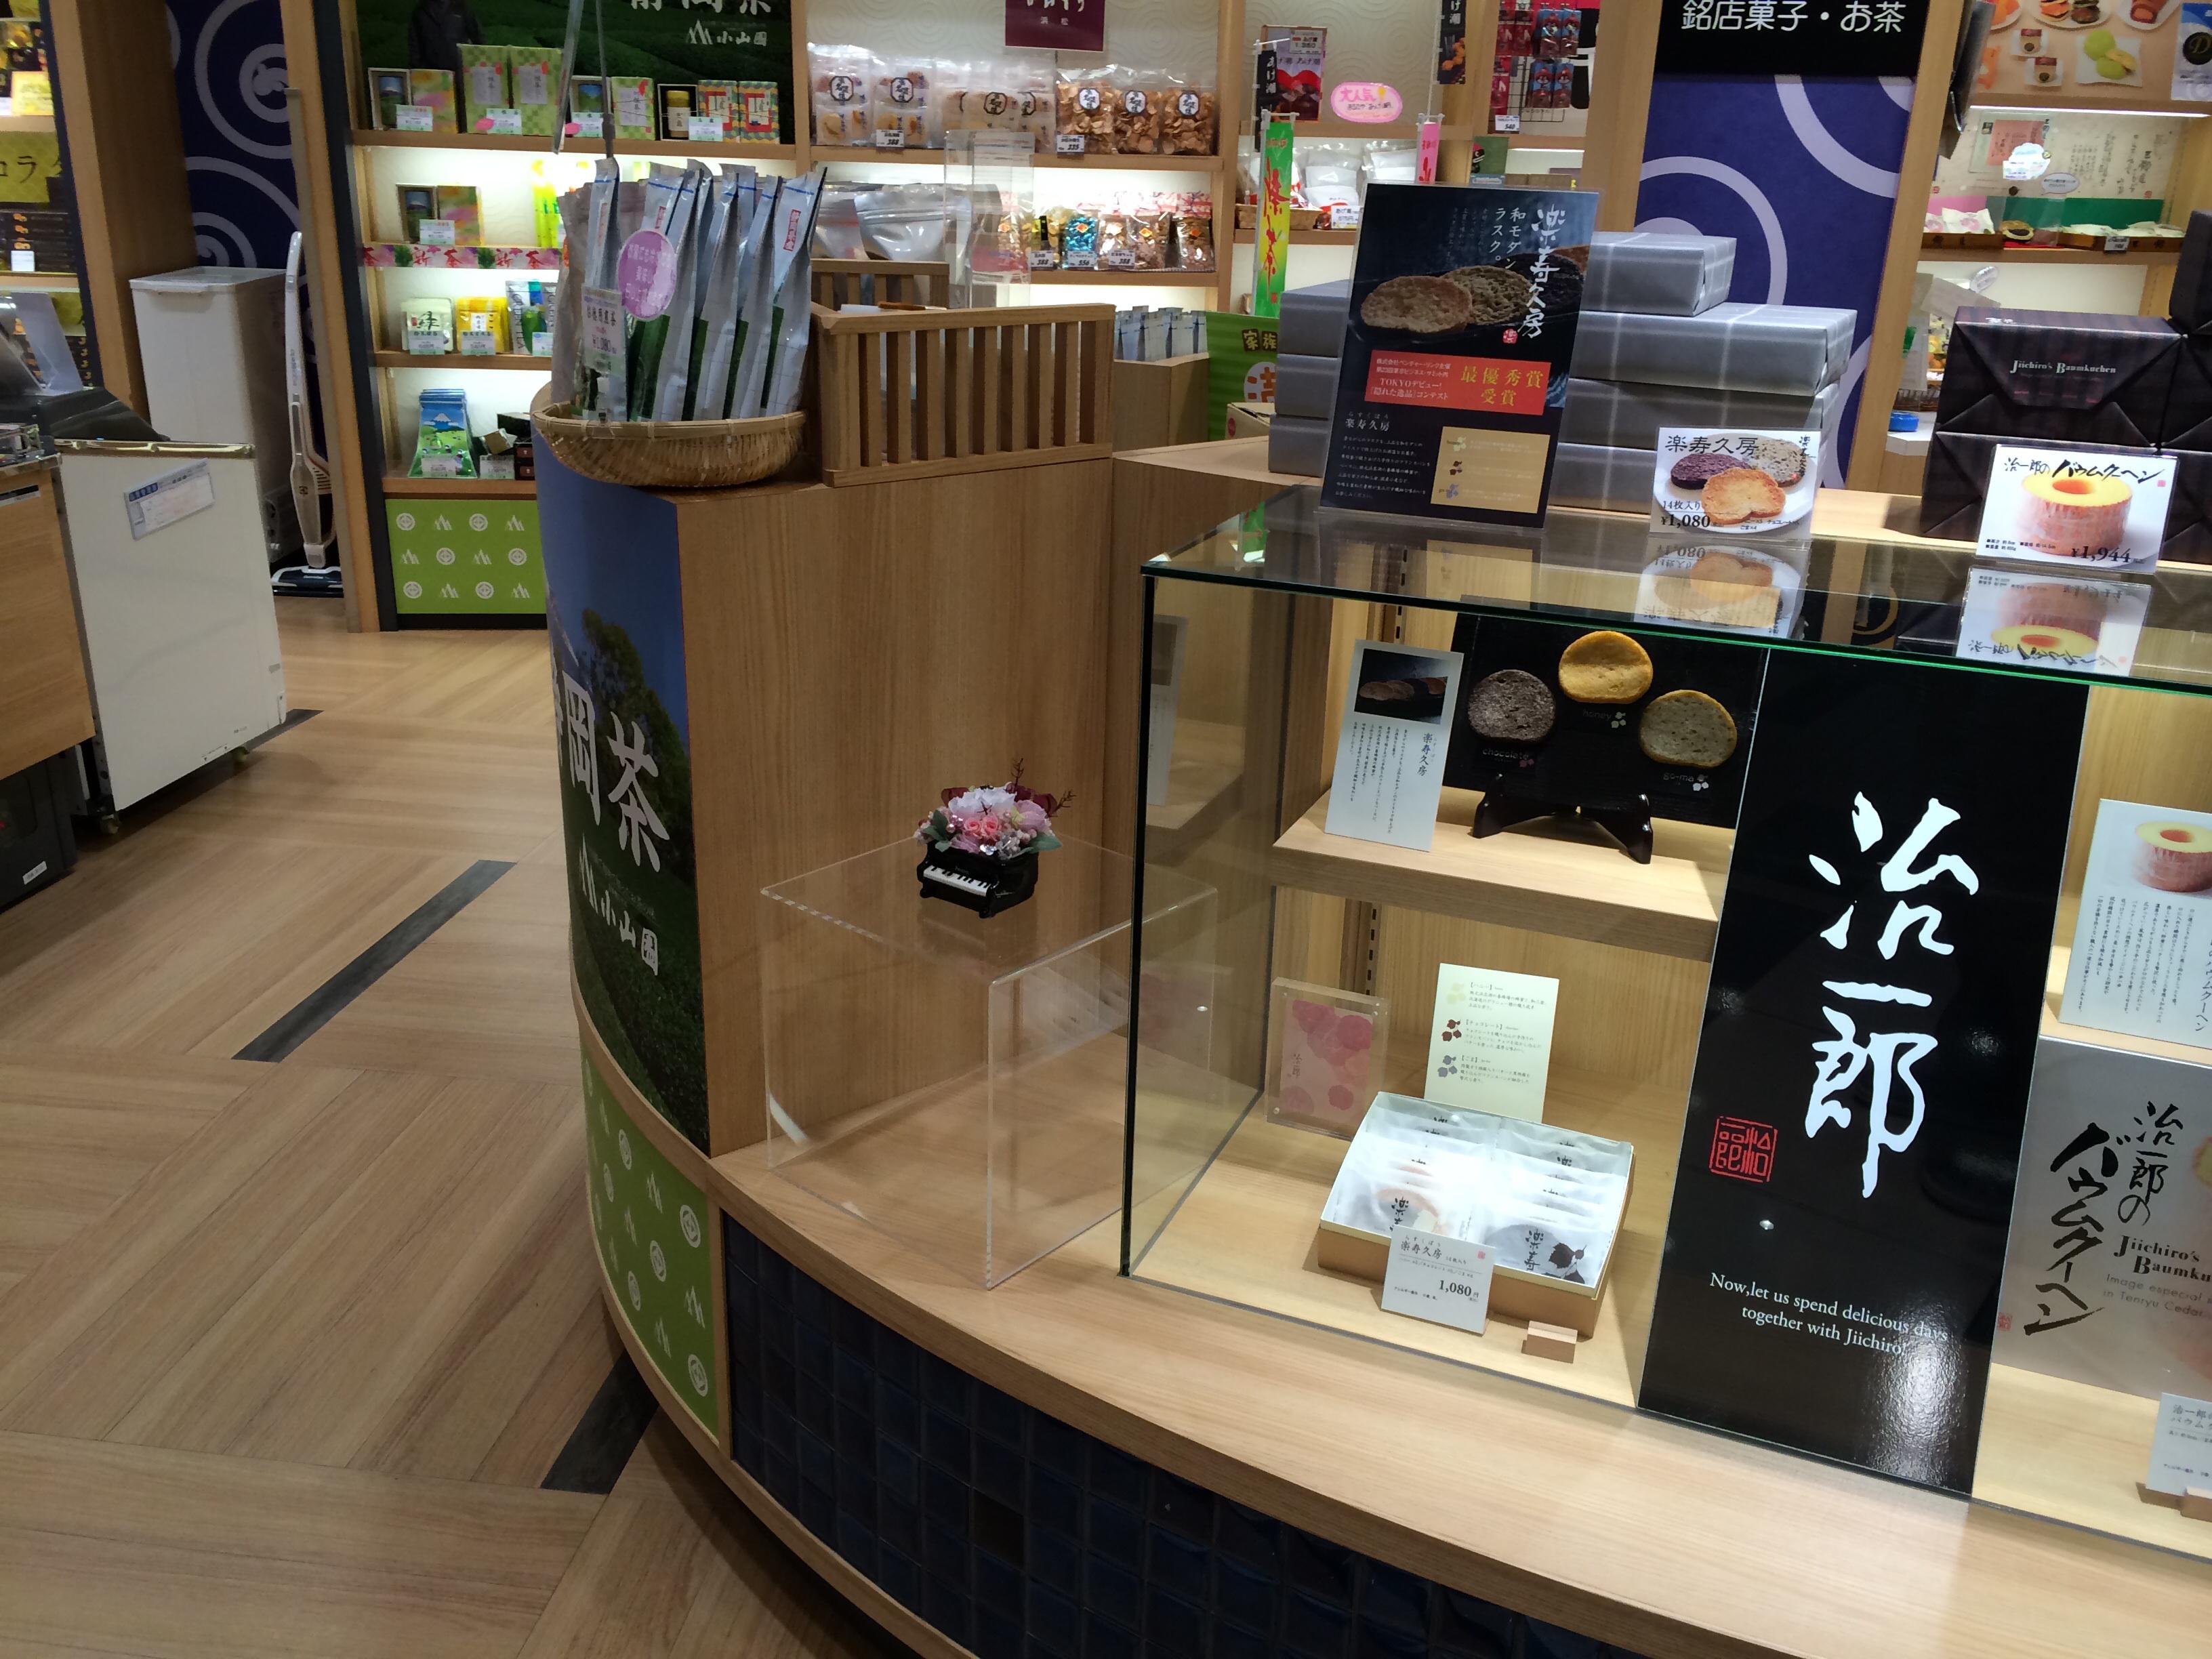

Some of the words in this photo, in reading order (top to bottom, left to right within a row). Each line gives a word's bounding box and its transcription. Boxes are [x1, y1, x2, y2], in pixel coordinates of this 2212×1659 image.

[1681, 0, 1906, 32] 銘店菓子・お茶
[1505, 207, 1526, 269] 和モダン
[1517, 204, 1565, 338] 楽寿久房
[1242, 329, 1277, 351] 家族
[1461, 365, 1544, 388] 最優秀賞
[1481, 388, 1517, 406] 受賞
[1665, 434, 1758, 455] 楽寿久房
[1661, 513, 1711, 529] ¥1,080
[2071, 545, 2132, 564] ¥1,944
[552, 657, 670, 872] 岡茶
[1417, 733, 1433, 777] 楽寿久房
[1805, 792, 1980, 1199] 治一郎
[2118, 1101, 2184, 1226] 治一郎の
[2024, 1122, 2131, 1336] バウムクーヘン
[2114, 1235, 2200, 1262] Jiichiro's
[2106, 1274, 2144, 1290] Image
[2120, 1291, 2158, 1308] Tenryu
[1742, 1307, 1803, 1332] together
[1807, 1322, 1841, 1340] with
[1774, 1292, 1790, 1305] us
[1793, 1296, 1838, 1317] spend
[1842, 1305, 1910, 1333] delicious
[1914, 1320, 1948, 1343] days
